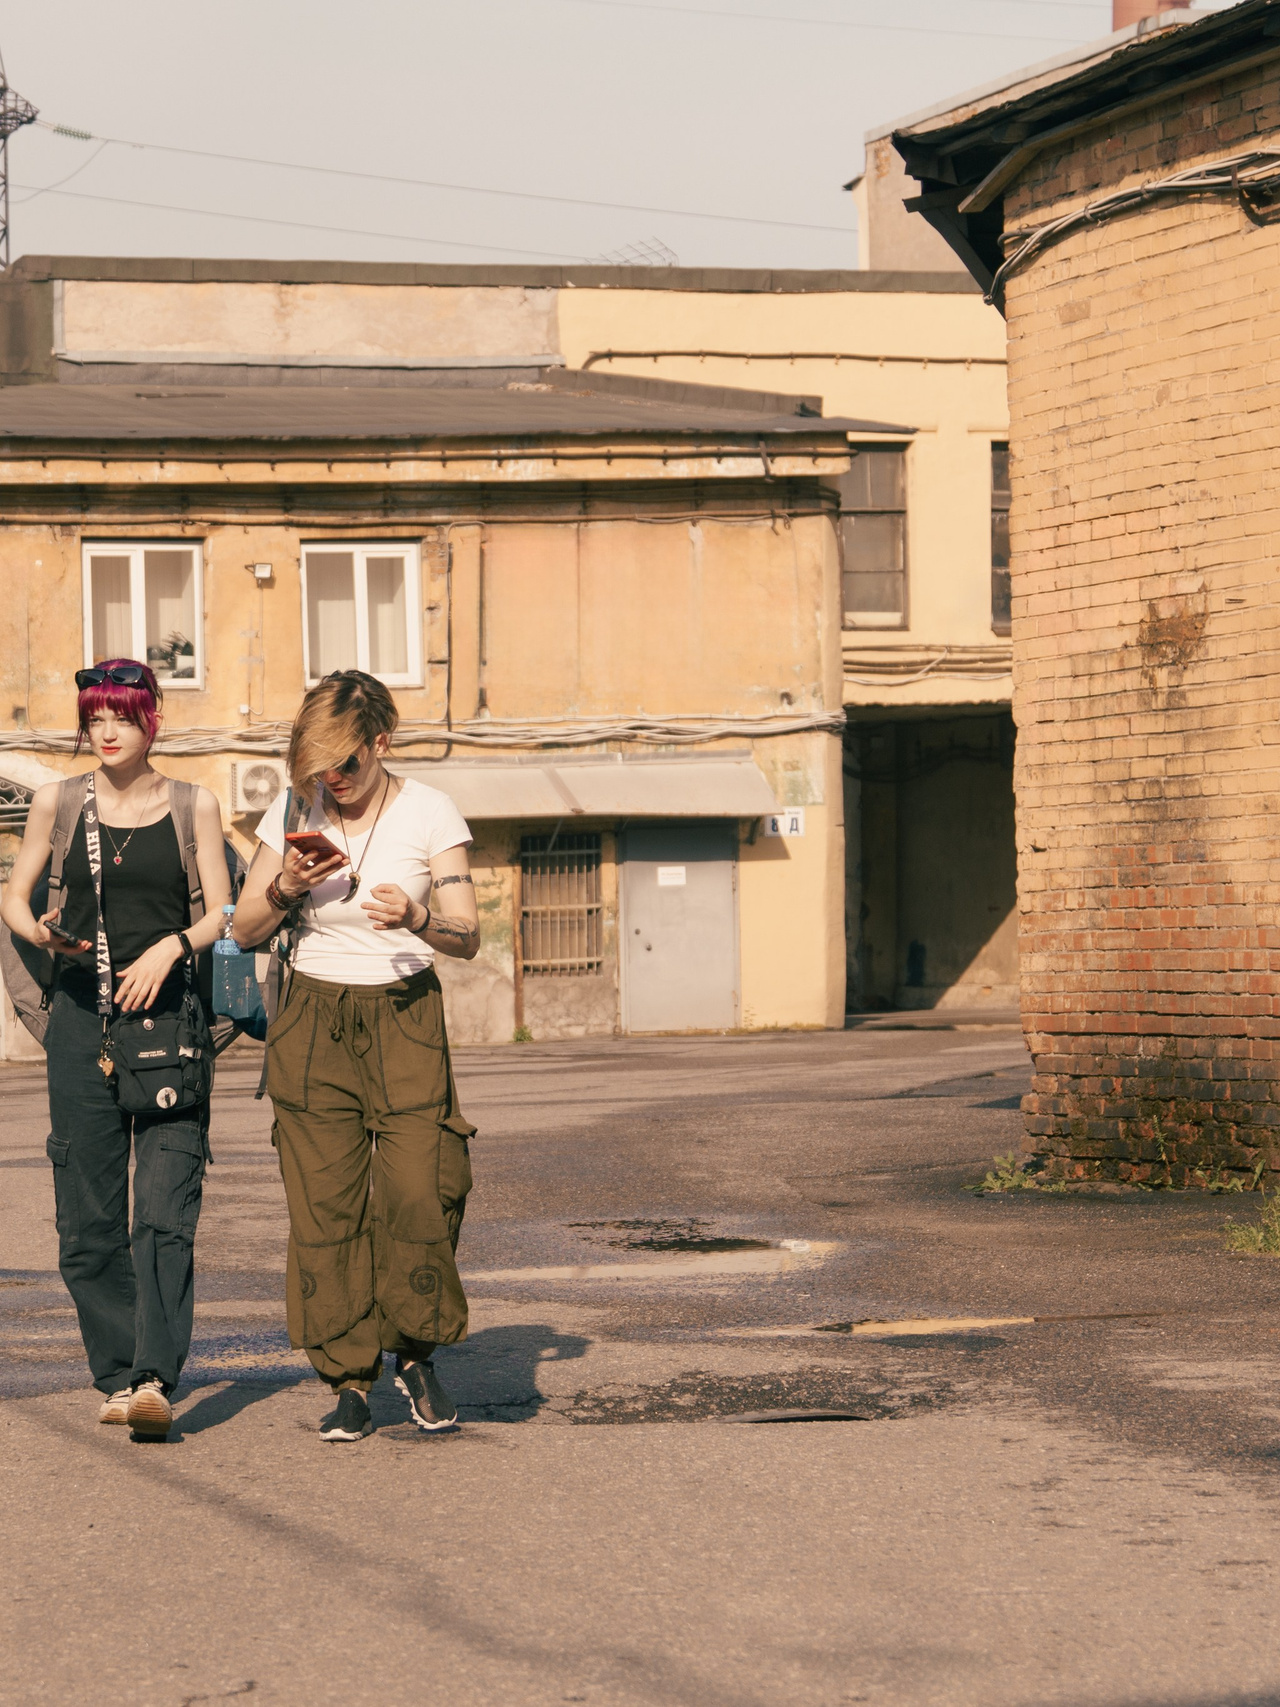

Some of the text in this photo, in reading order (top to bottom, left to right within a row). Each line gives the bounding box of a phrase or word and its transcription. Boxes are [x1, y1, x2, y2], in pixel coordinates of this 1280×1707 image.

[771, 817, 799, 833] 8 Д
[86, 830, 101, 875] HIYA
[96, 930, 111, 974] HIYA
